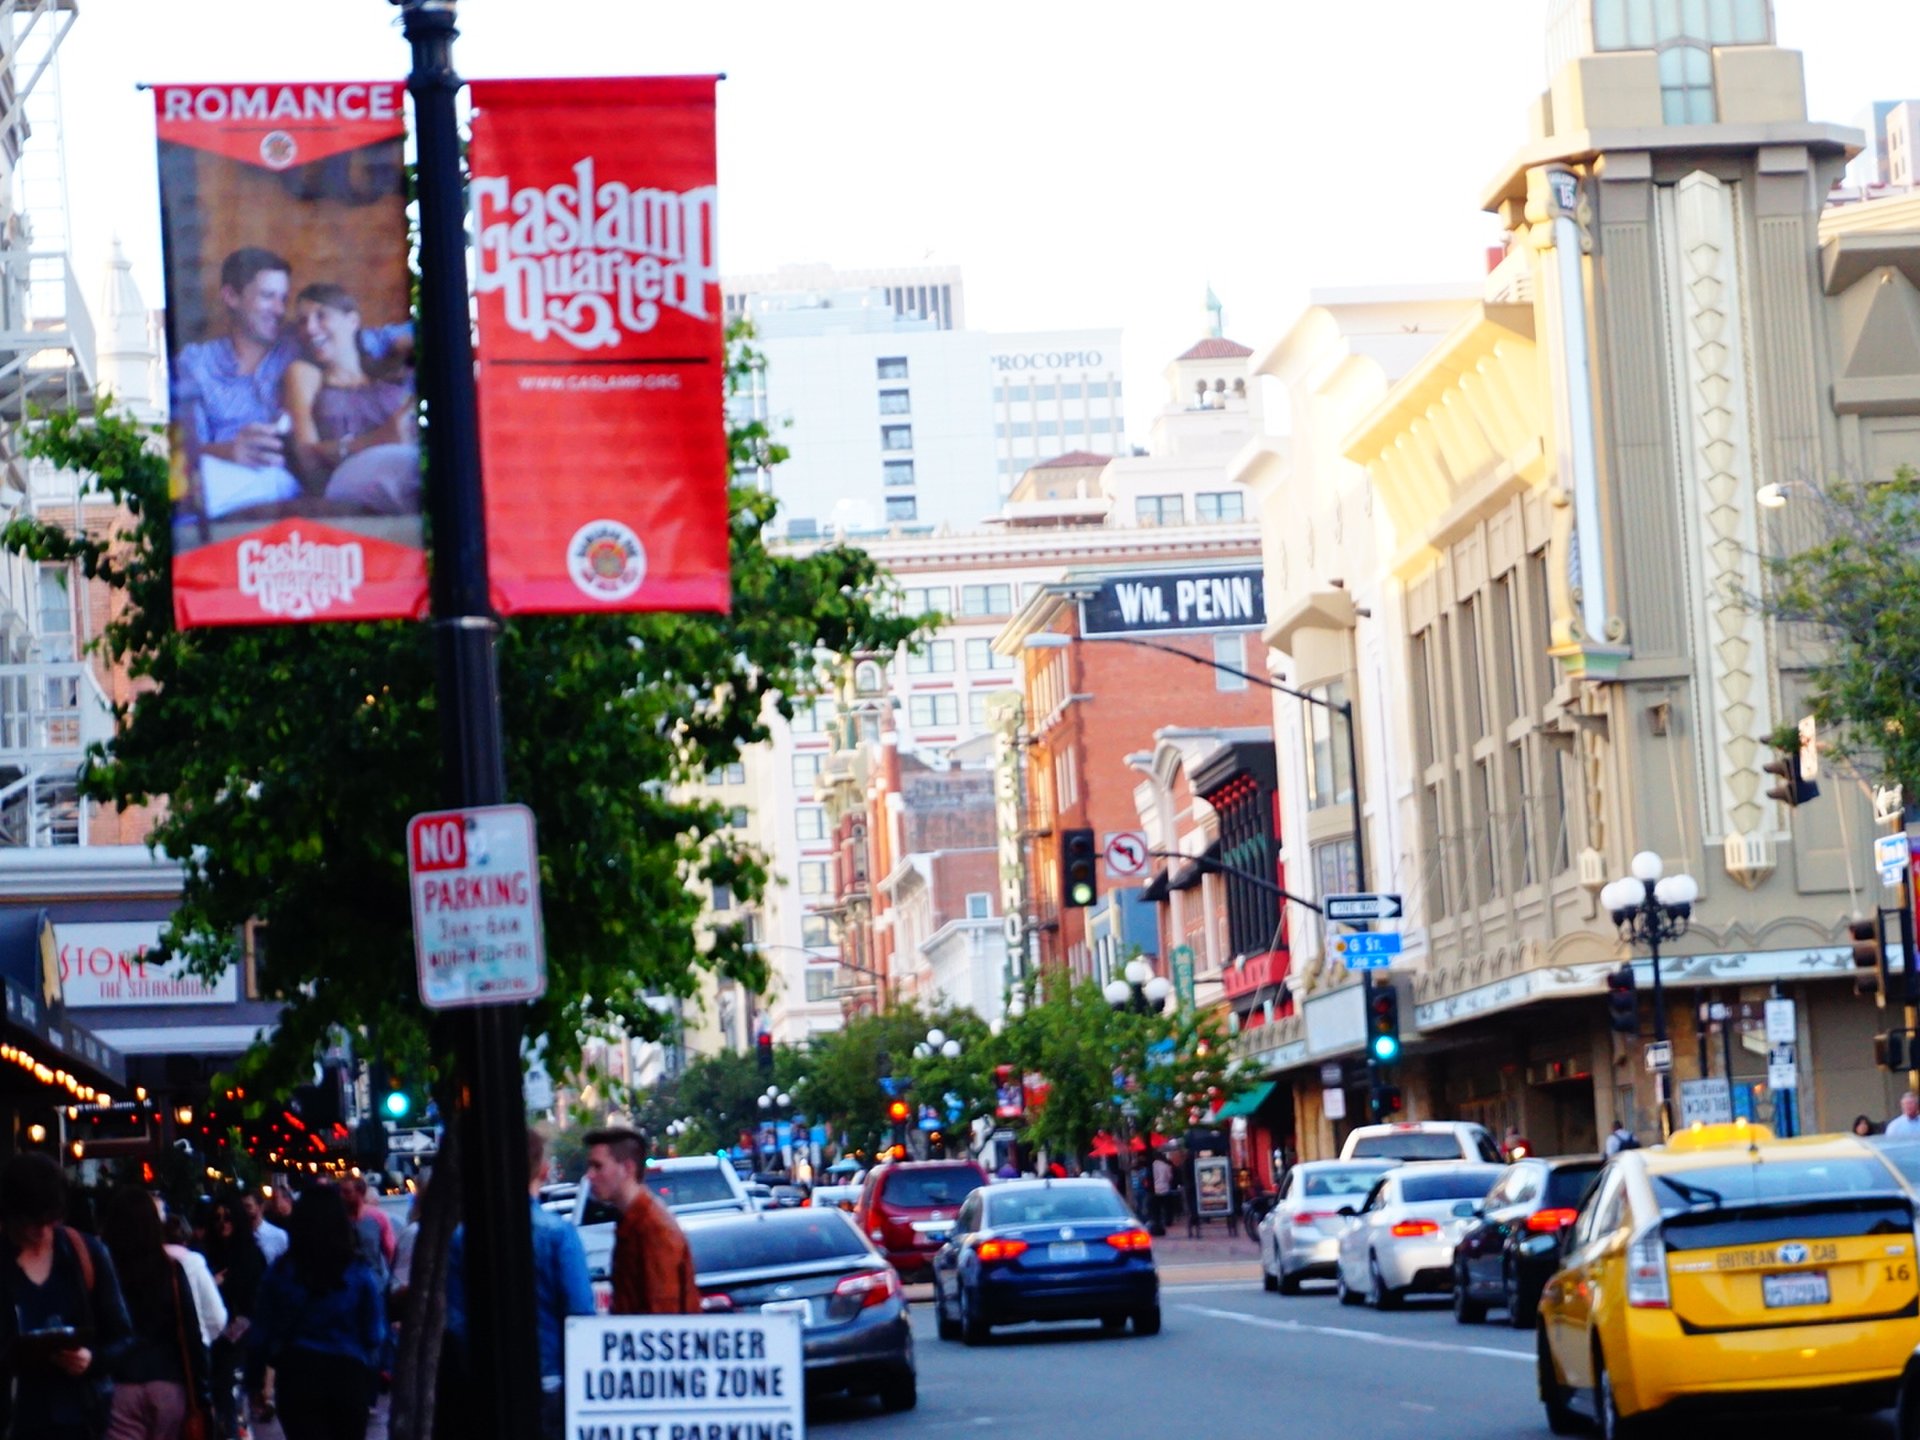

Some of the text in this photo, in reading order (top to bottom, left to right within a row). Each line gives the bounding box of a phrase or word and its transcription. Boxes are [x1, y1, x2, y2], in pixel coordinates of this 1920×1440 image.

[163, 84, 395, 122] ROMANCE
[469, 156, 719, 318] Gaslamp
[500, 250, 704, 349] Quarter
[991, 350, 1103, 371] ROCOPIO
[237, 530, 364, 600] Gaslamp
[1176, 577, 1253, 622] PENN
[419, 822, 462, 864] NO
[424, 872, 529, 913] PARKING
[1335, 901, 1378, 913] ONE WAY
[60, 943, 148, 984] STONE
[1349, 938, 1360, 953] G
[100, 981, 121, 999] THE
[1812, 1244, 1838, 1261] CAB
[1885, 1265, 1910, 1281] 16
[603, 1329, 766, 1362] PASSENGER
[585, 1366, 784, 1400] LOADING ZONE
